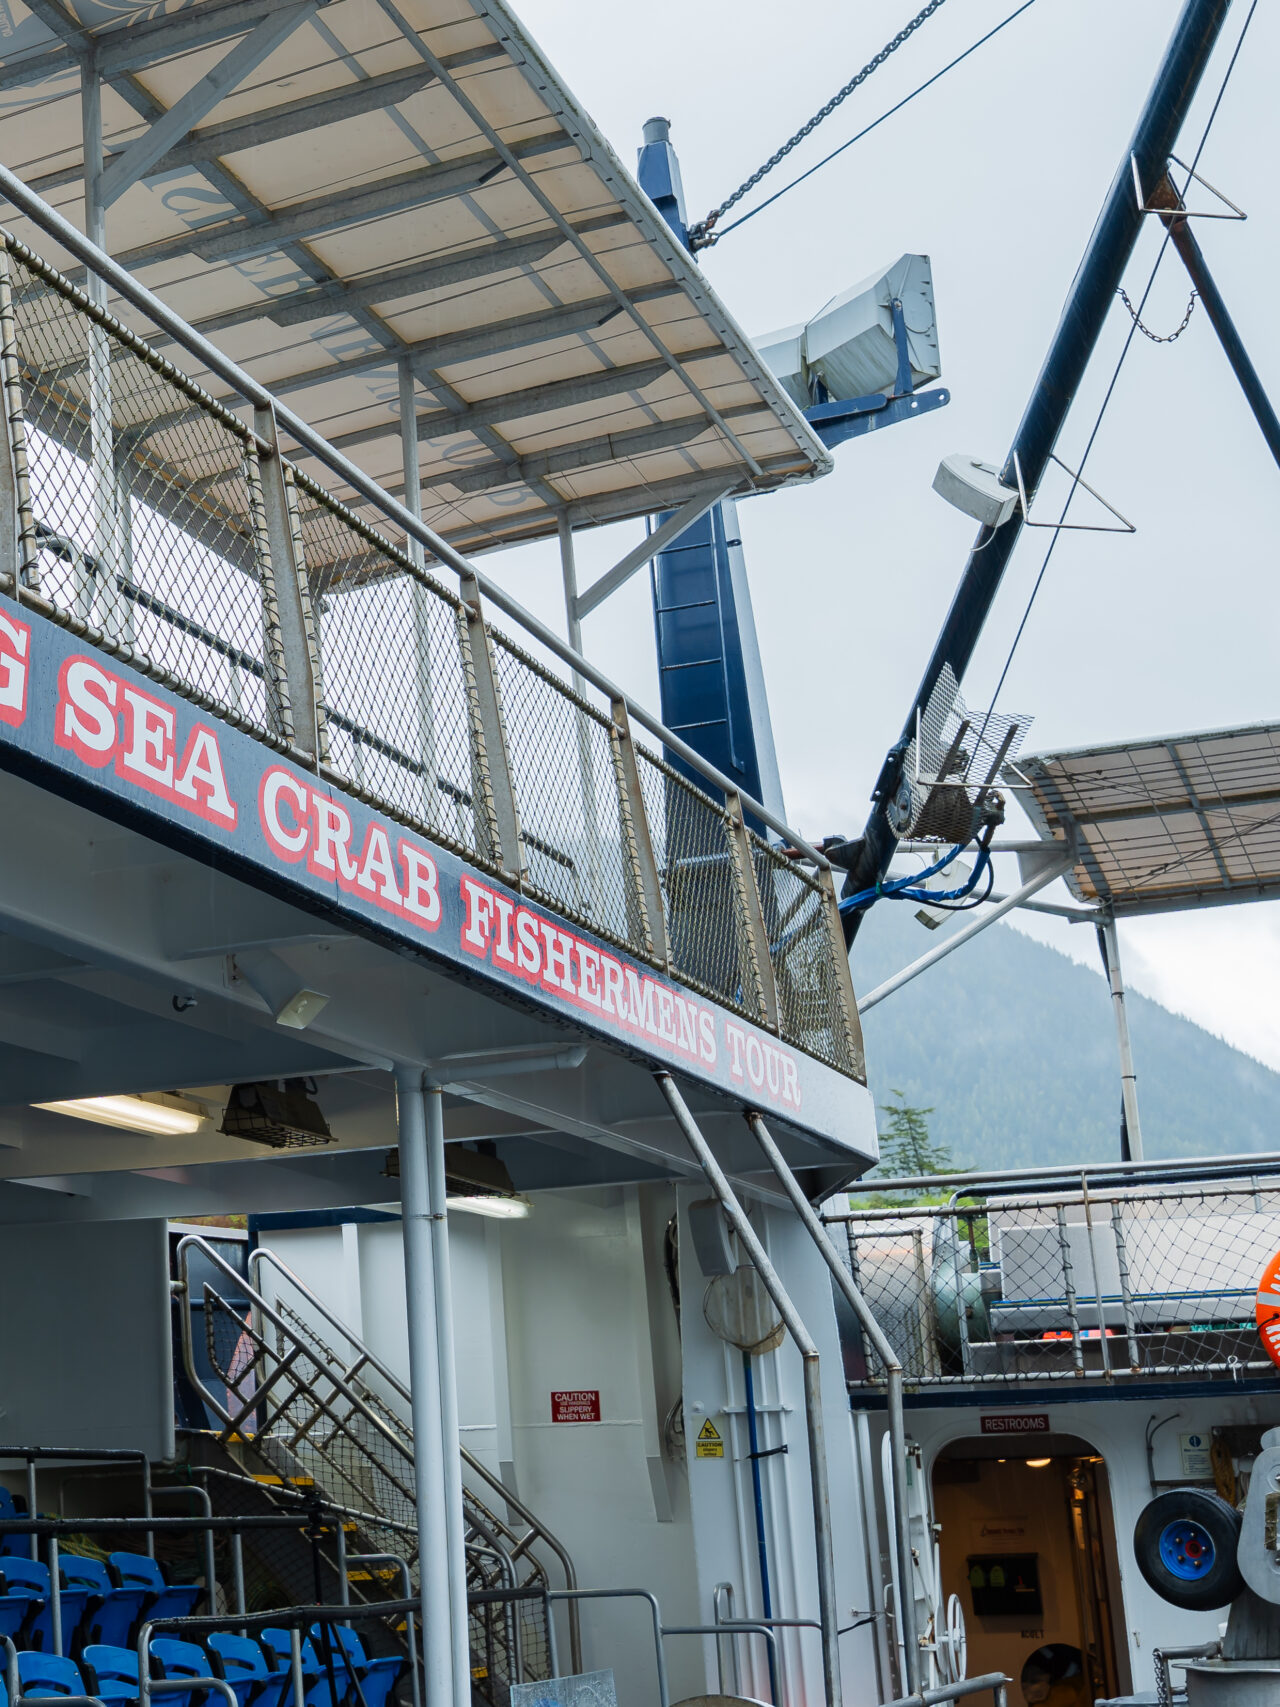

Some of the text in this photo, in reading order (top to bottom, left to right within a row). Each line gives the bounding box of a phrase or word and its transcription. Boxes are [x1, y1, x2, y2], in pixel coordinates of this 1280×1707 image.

[63, 661, 236, 820] SEA
[263, 773, 439, 924] CRAB
[464, 884, 716, 1062] FISHERMENS
[726, 1024, 802, 1104] TOUR
[554, 1392, 595, 1401] CAUTION
[559, 1405, 592, 1413] SLIPPERY
[985, 1418, 1046, 1430] RESTROOMS
